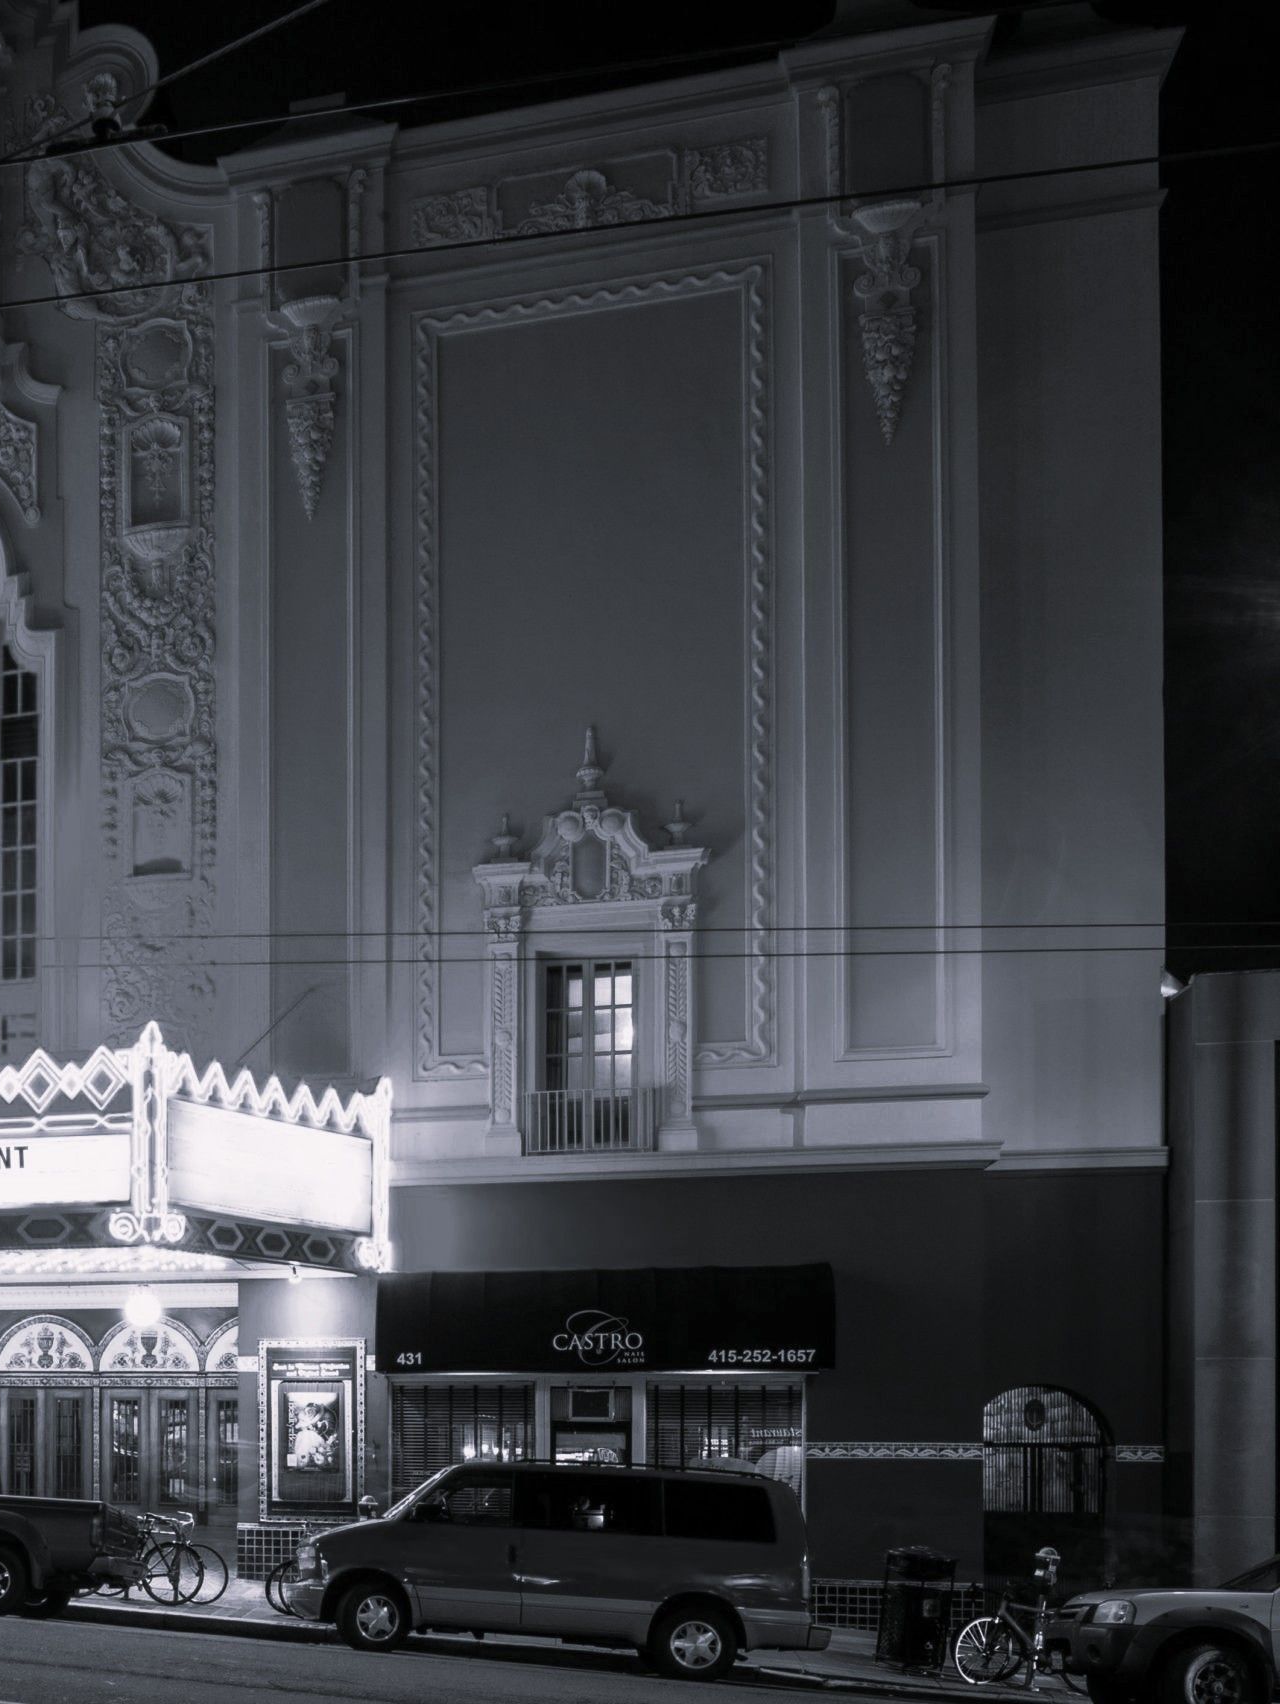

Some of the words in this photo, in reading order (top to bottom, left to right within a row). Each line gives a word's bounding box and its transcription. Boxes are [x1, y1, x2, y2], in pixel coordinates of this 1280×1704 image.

[552, 1332, 644, 1351] CASTRO
[396, 1352, 423, 1366] 431
[616, 1357, 646, 1365] SALON
[708, 1349, 817, 1364] 415-252-1657
